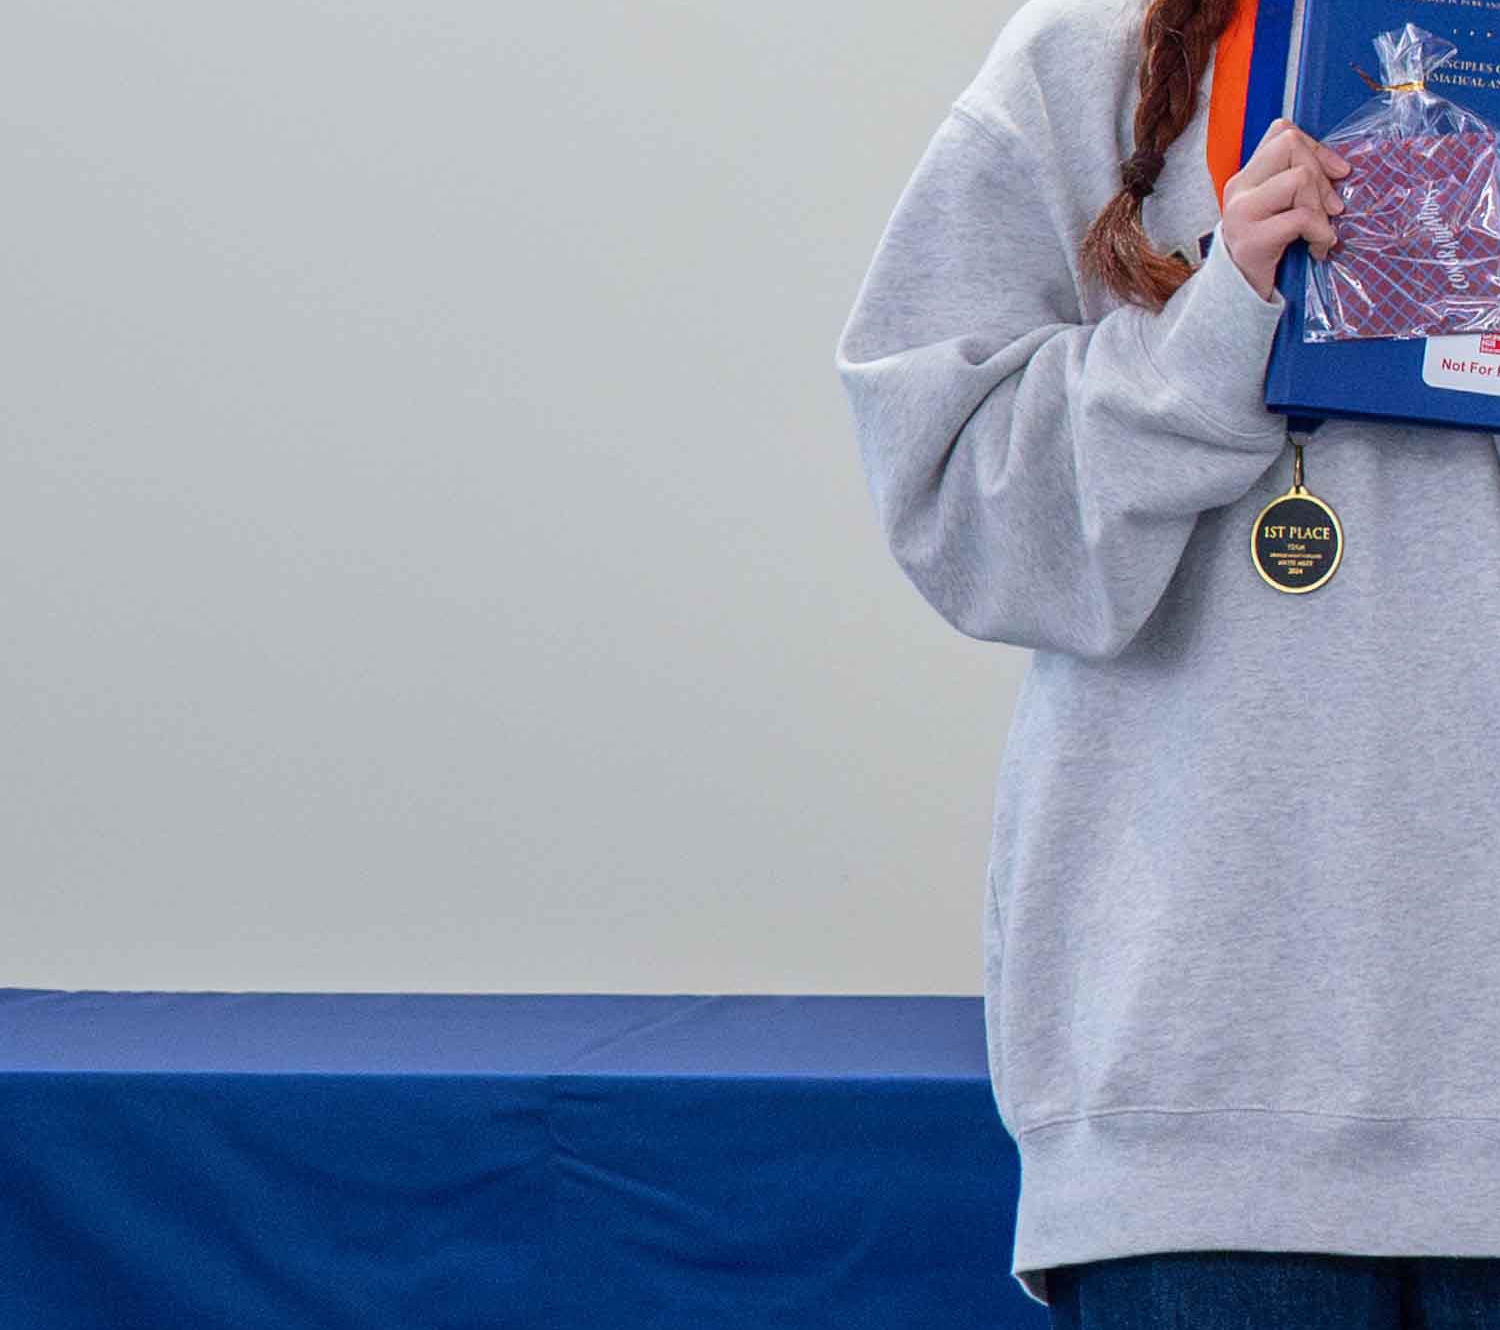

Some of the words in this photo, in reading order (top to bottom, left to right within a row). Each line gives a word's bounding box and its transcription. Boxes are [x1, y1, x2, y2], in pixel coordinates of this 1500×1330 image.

[1440, 358, 1465, 372] Not
[1469, 362, 1492, 376] For
[1264, 525, 1286, 539] 1ST
[1289, 526, 1330, 540] PLACE
